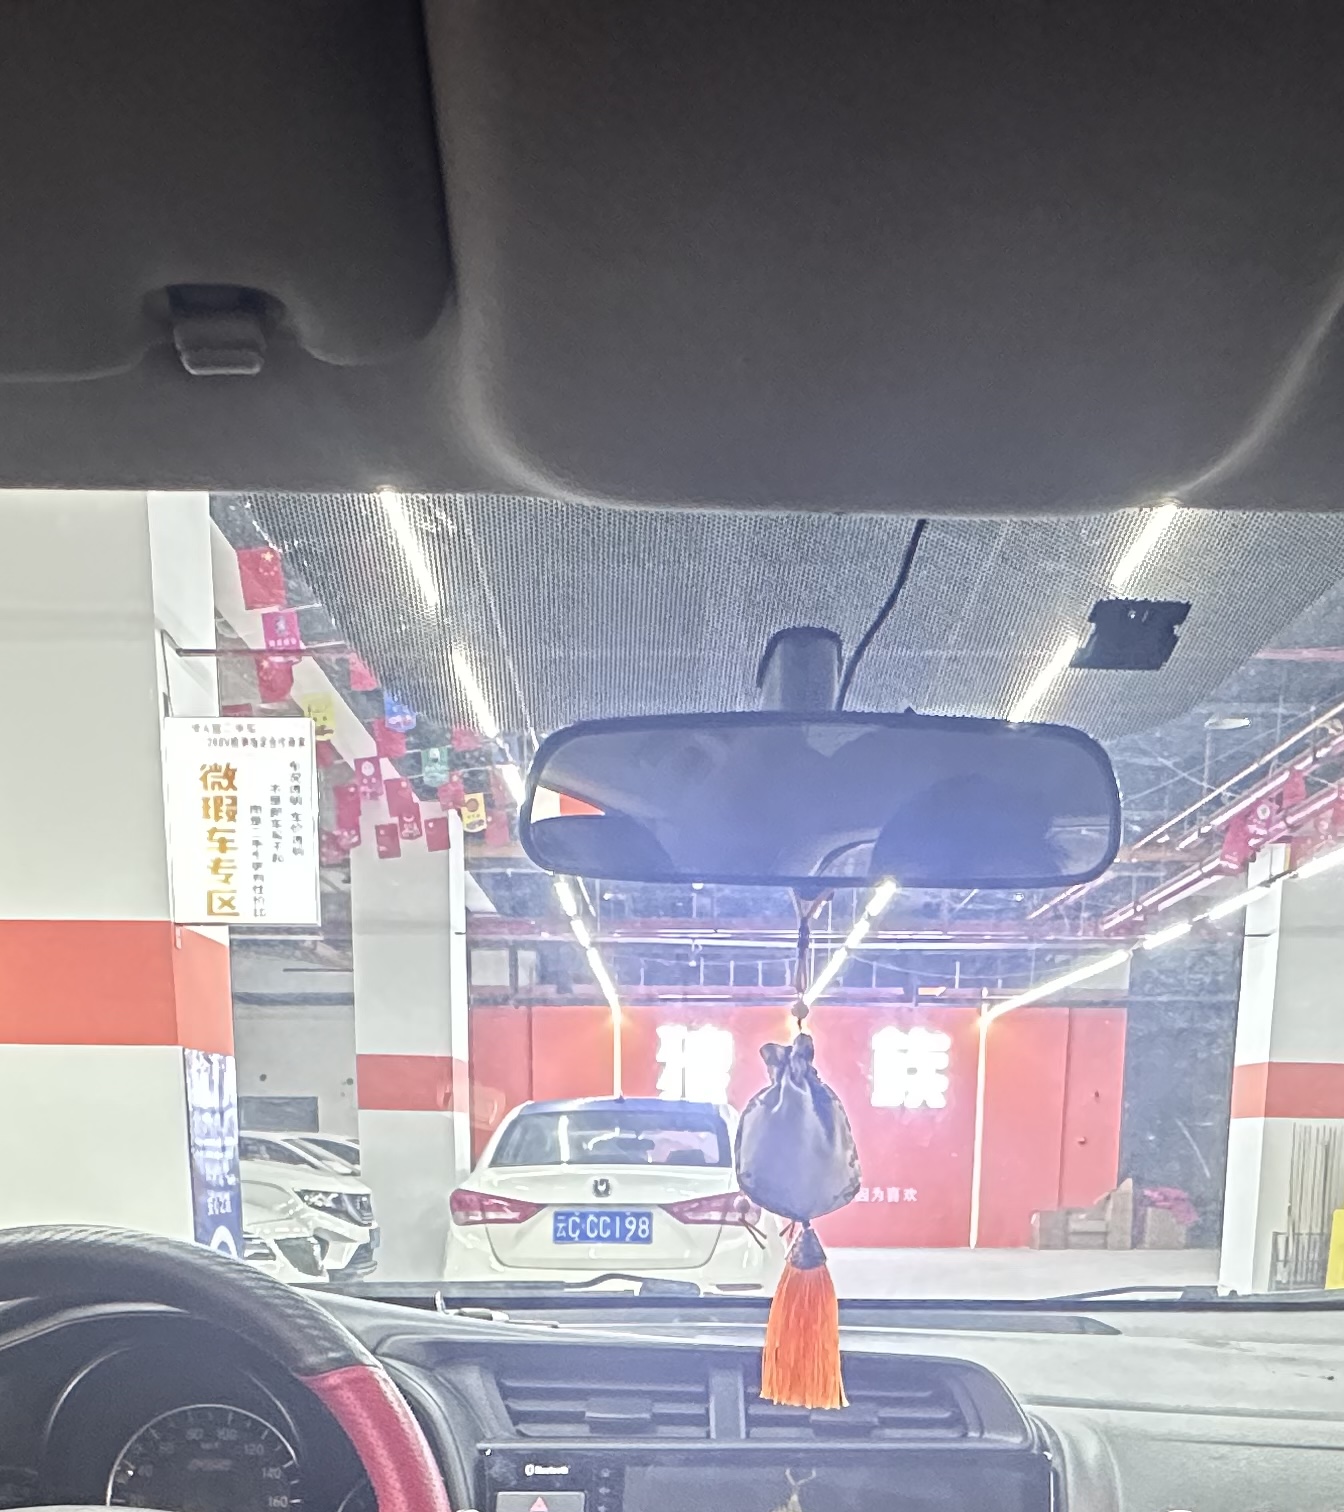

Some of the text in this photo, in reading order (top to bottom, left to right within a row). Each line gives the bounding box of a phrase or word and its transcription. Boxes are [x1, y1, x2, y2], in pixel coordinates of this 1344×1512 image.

[199, 762, 240, 917] 微瑕车专区
[267, 1495, 289, 1509] 160
